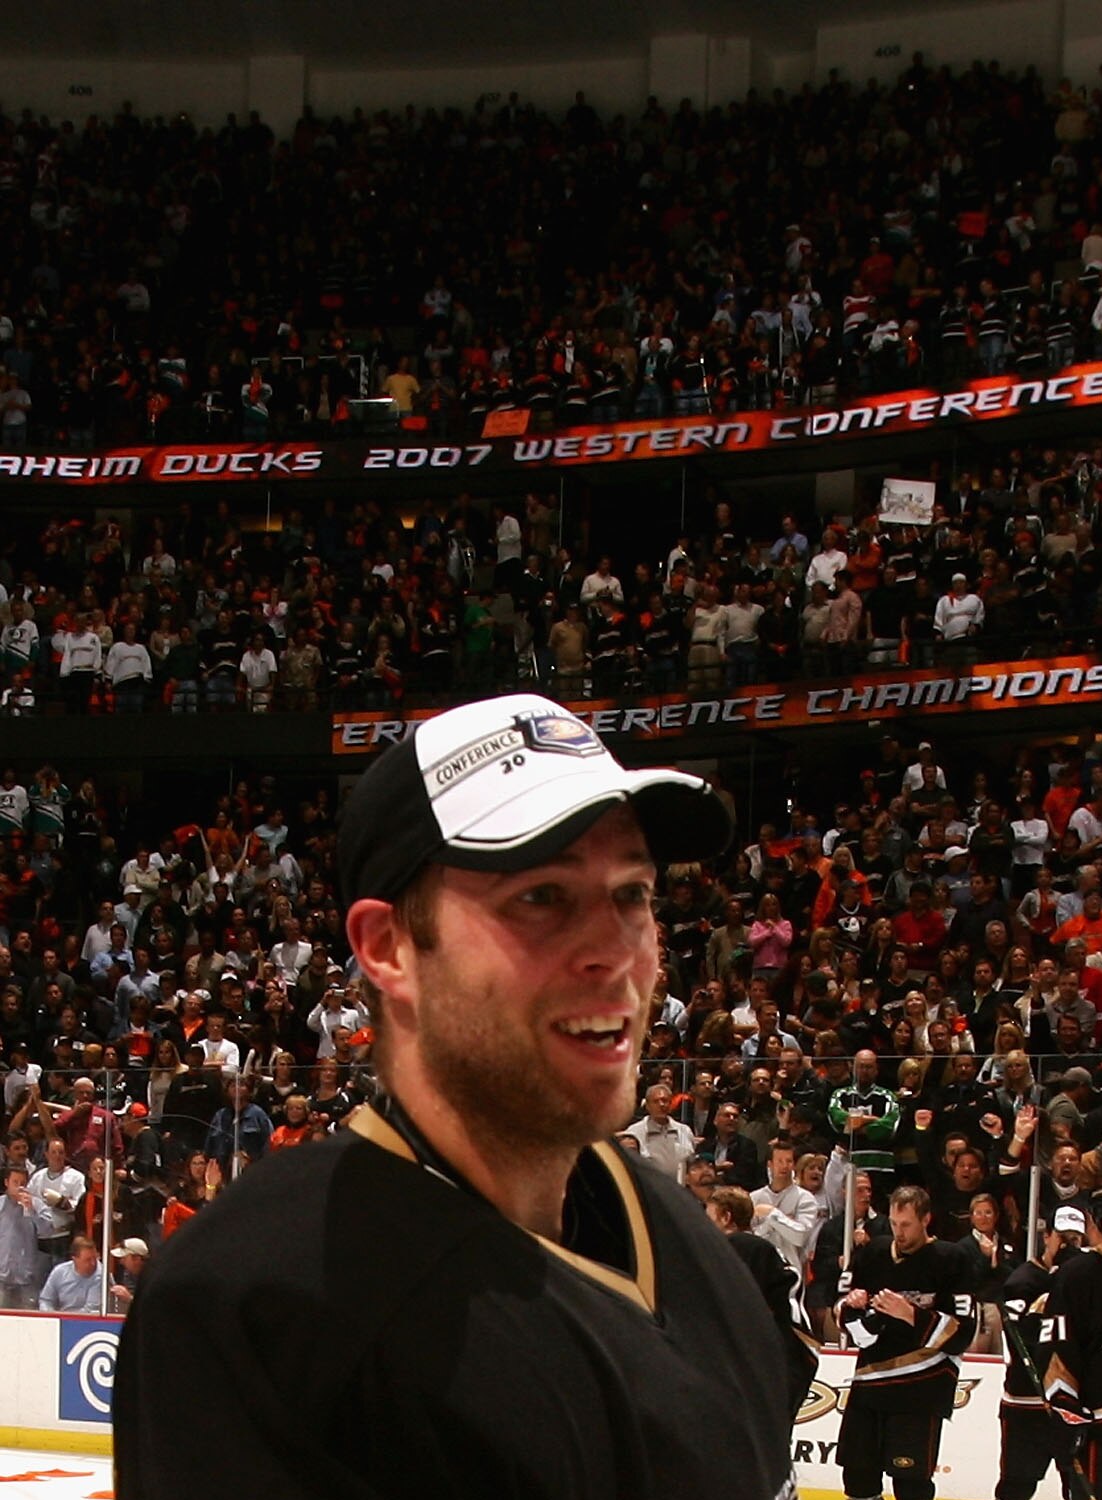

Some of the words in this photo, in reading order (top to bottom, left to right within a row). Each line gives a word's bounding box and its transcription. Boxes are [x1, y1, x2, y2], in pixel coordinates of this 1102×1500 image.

[0, 456, 142, 477] AHEIM
[160, 451, 323, 475] DUCKS
[363, 445, 493, 469] 2007
[513, 422, 749, 461] WESTERN
[573, 693, 786, 735] ERENCE
[436, 732, 519, 785] CONFERENCE
[954, 1293, 975, 1319] 3
[1038, 1315, 1067, 1343] 21
[792, 1440, 840, 1464] RY
